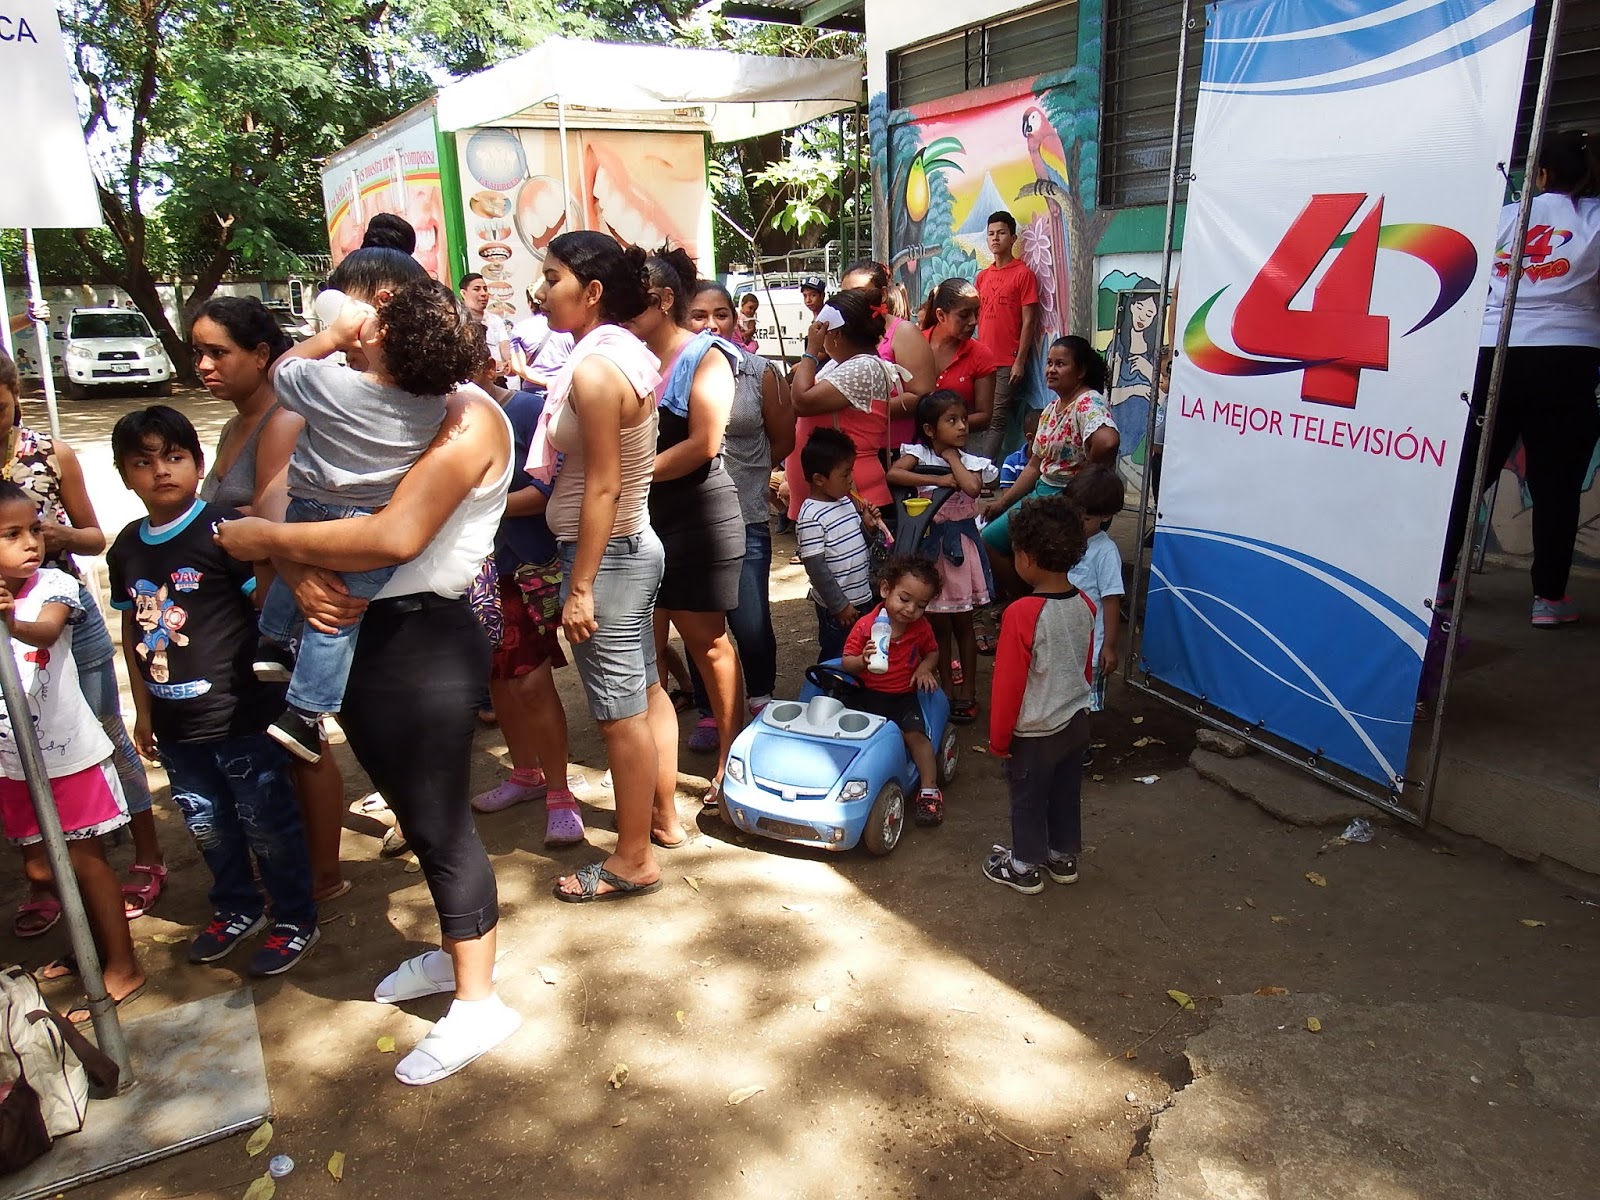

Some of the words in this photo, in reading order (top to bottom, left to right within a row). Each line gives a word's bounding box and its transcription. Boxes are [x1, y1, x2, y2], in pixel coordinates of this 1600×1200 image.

[1510, 224, 1553, 263] 4
[1231, 192, 1389, 409] 4
[1181, 395, 1205, 420] LA
[1213, 400, 1283, 436] MEJOR
[1289, 413, 1447, 467] TELEVISIÓN
[170, 572, 203, 584] PAW
